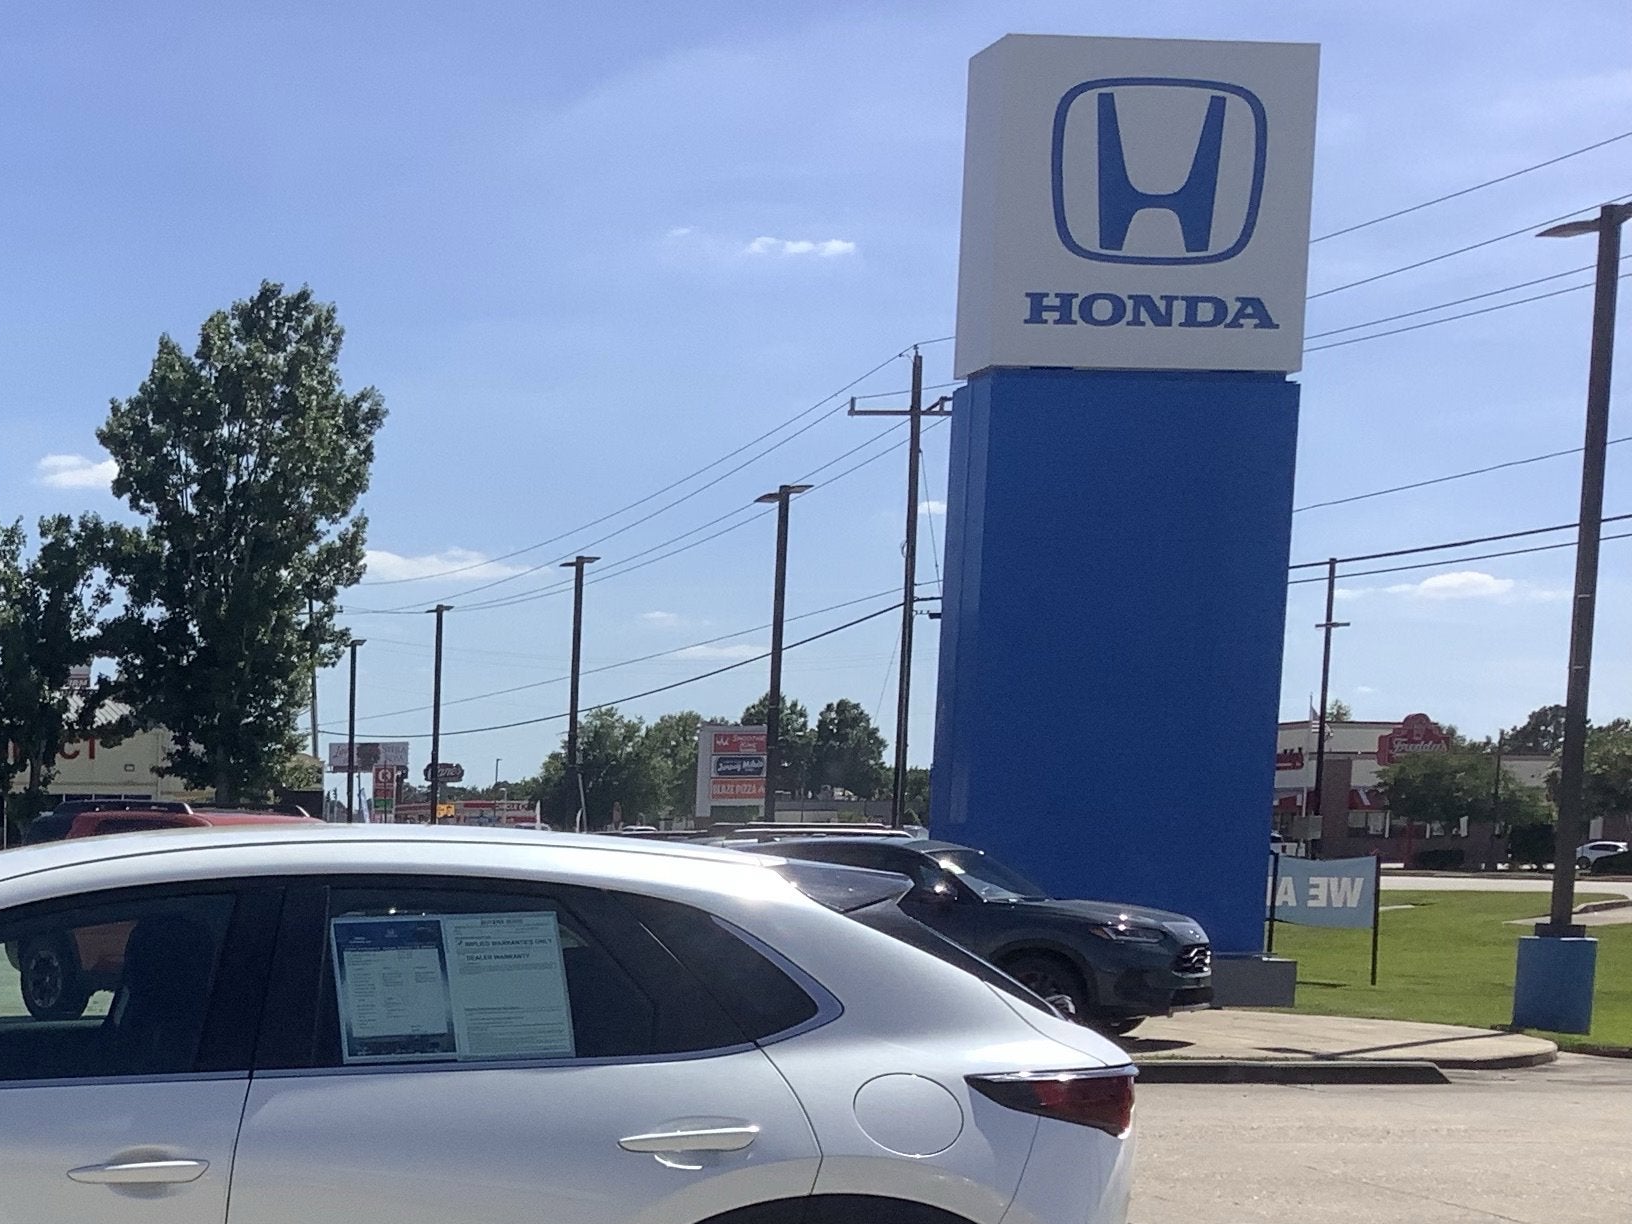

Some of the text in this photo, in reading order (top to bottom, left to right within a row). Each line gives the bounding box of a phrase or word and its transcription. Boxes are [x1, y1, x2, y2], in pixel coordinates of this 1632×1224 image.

[1023, 292, 1281, 329] HONDA
[713, 783, 757, 794] BLAZE PIZZA
